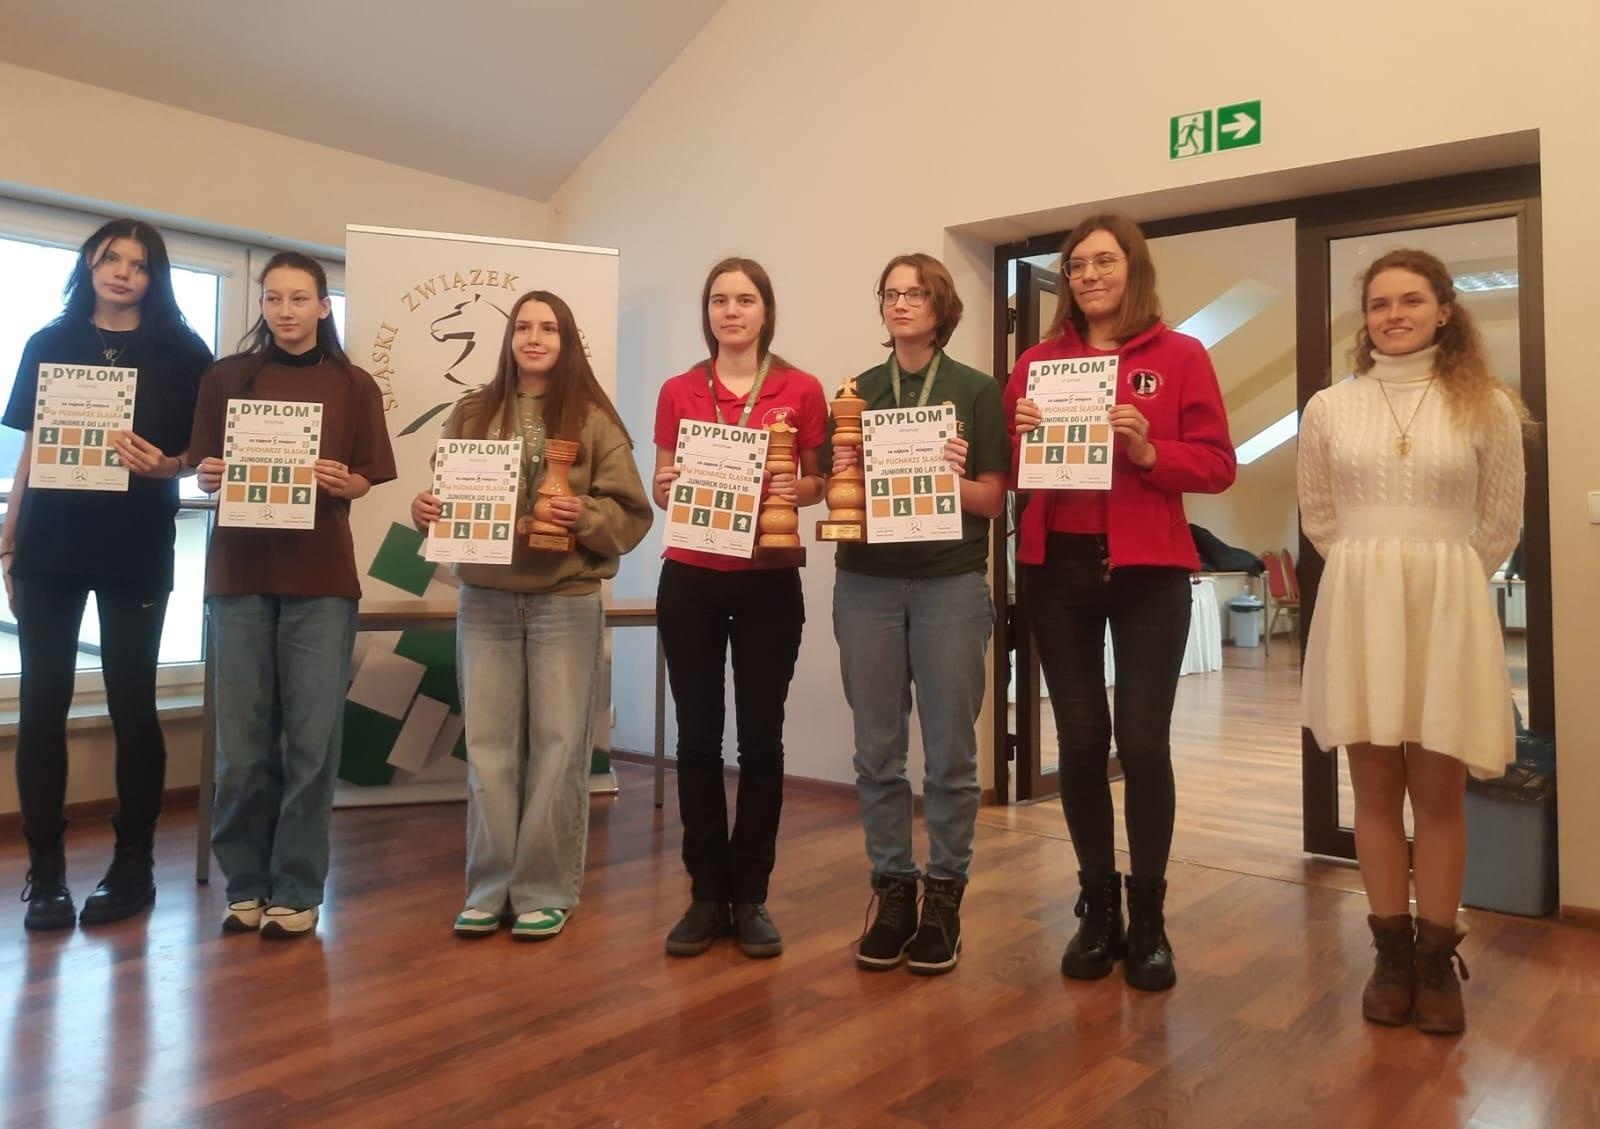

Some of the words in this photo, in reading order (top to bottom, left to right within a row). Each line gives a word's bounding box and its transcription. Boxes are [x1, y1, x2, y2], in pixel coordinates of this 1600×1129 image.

[400, 268, 521, 312] ZWIĄZEK
[53, 367, 123, 382] DYPLOM
[1041, 361, 1105, 376] DYPLOM
[241, 403, 309, 418] DYPLOM
[874, 409, 942, 426] DYPLOM
[691, 424, 756, 444] DYPLOM
[448, 442, 510, 455] DYPLOM
[880, 467, 912, 476] JUNIOREK
[914, 466, 923, 474] DO
[687, 477, 719, 488] JUNIOREK
[728, 483, 740, 491] LAT
